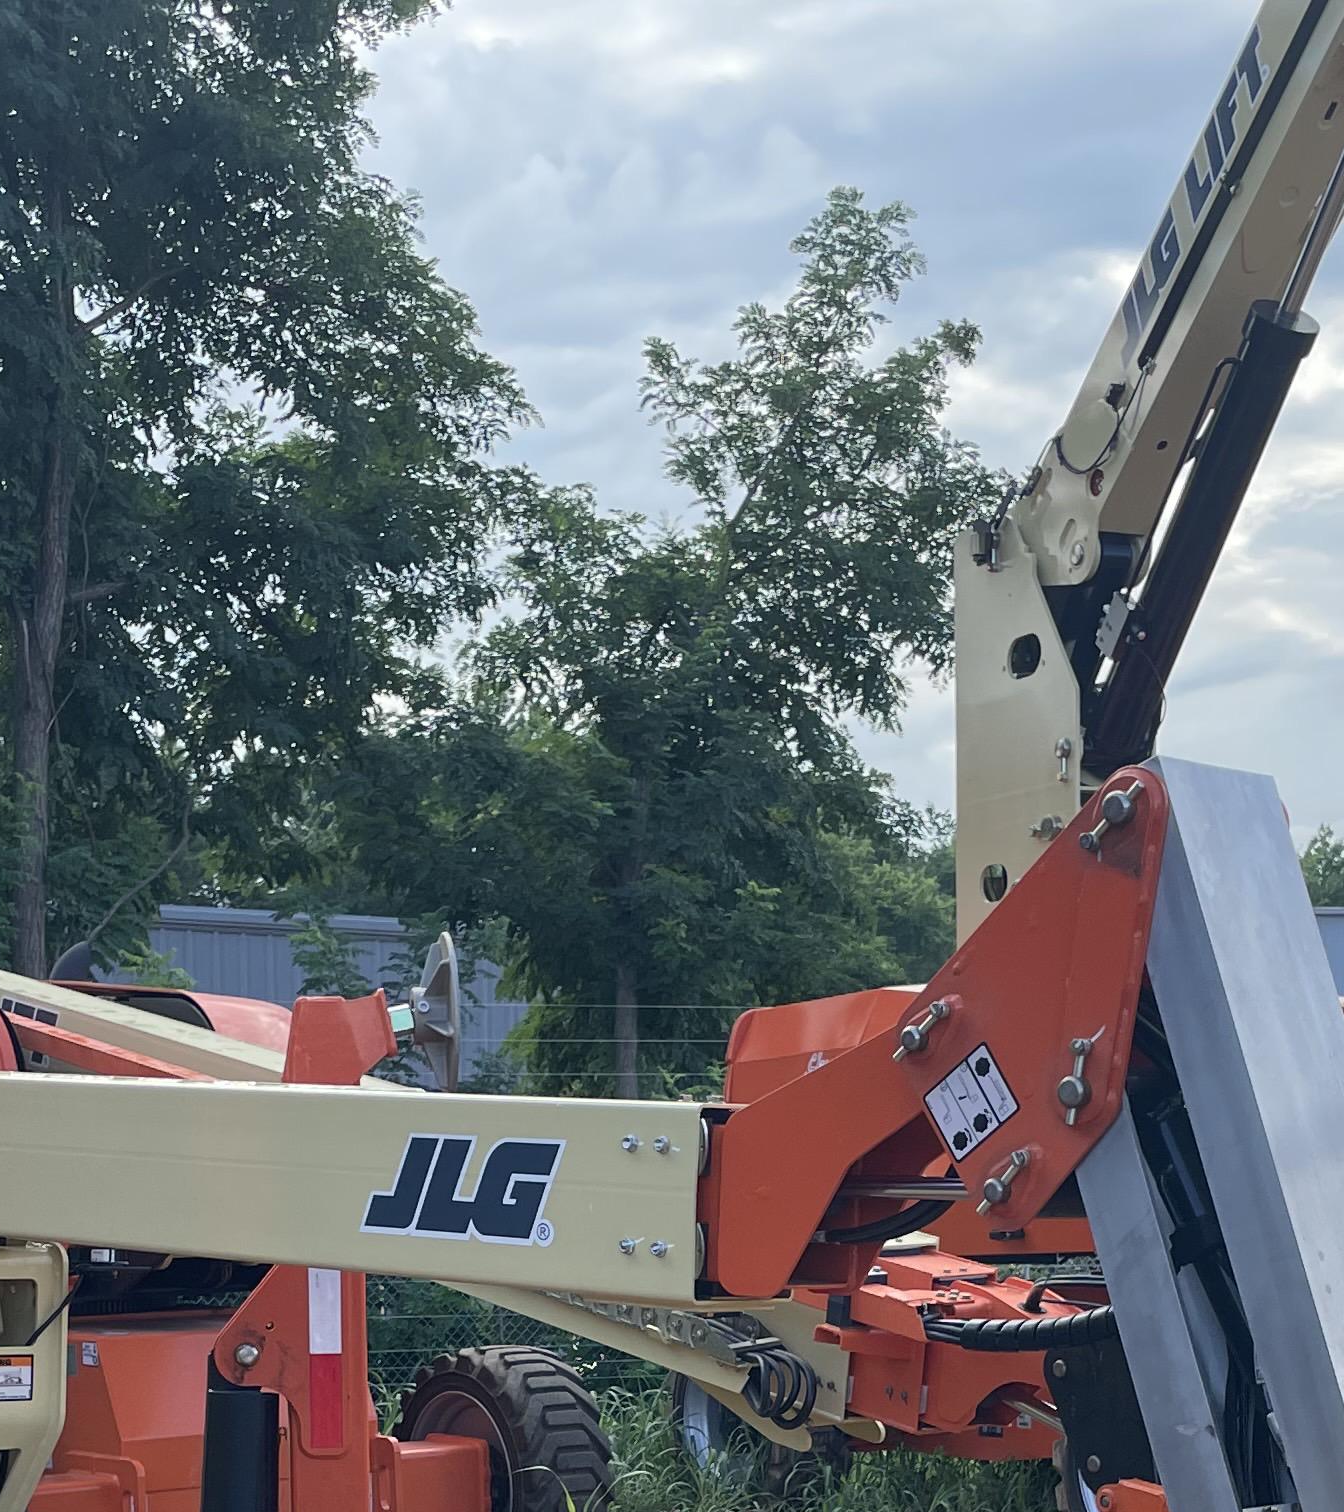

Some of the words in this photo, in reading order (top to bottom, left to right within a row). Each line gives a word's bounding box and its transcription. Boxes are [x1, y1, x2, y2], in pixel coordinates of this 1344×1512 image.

[1120, 205, 1182, 372] JLG
[1184, 24, 1264, 227] LIFT
[364, 1136, 562, 1240] JLG
